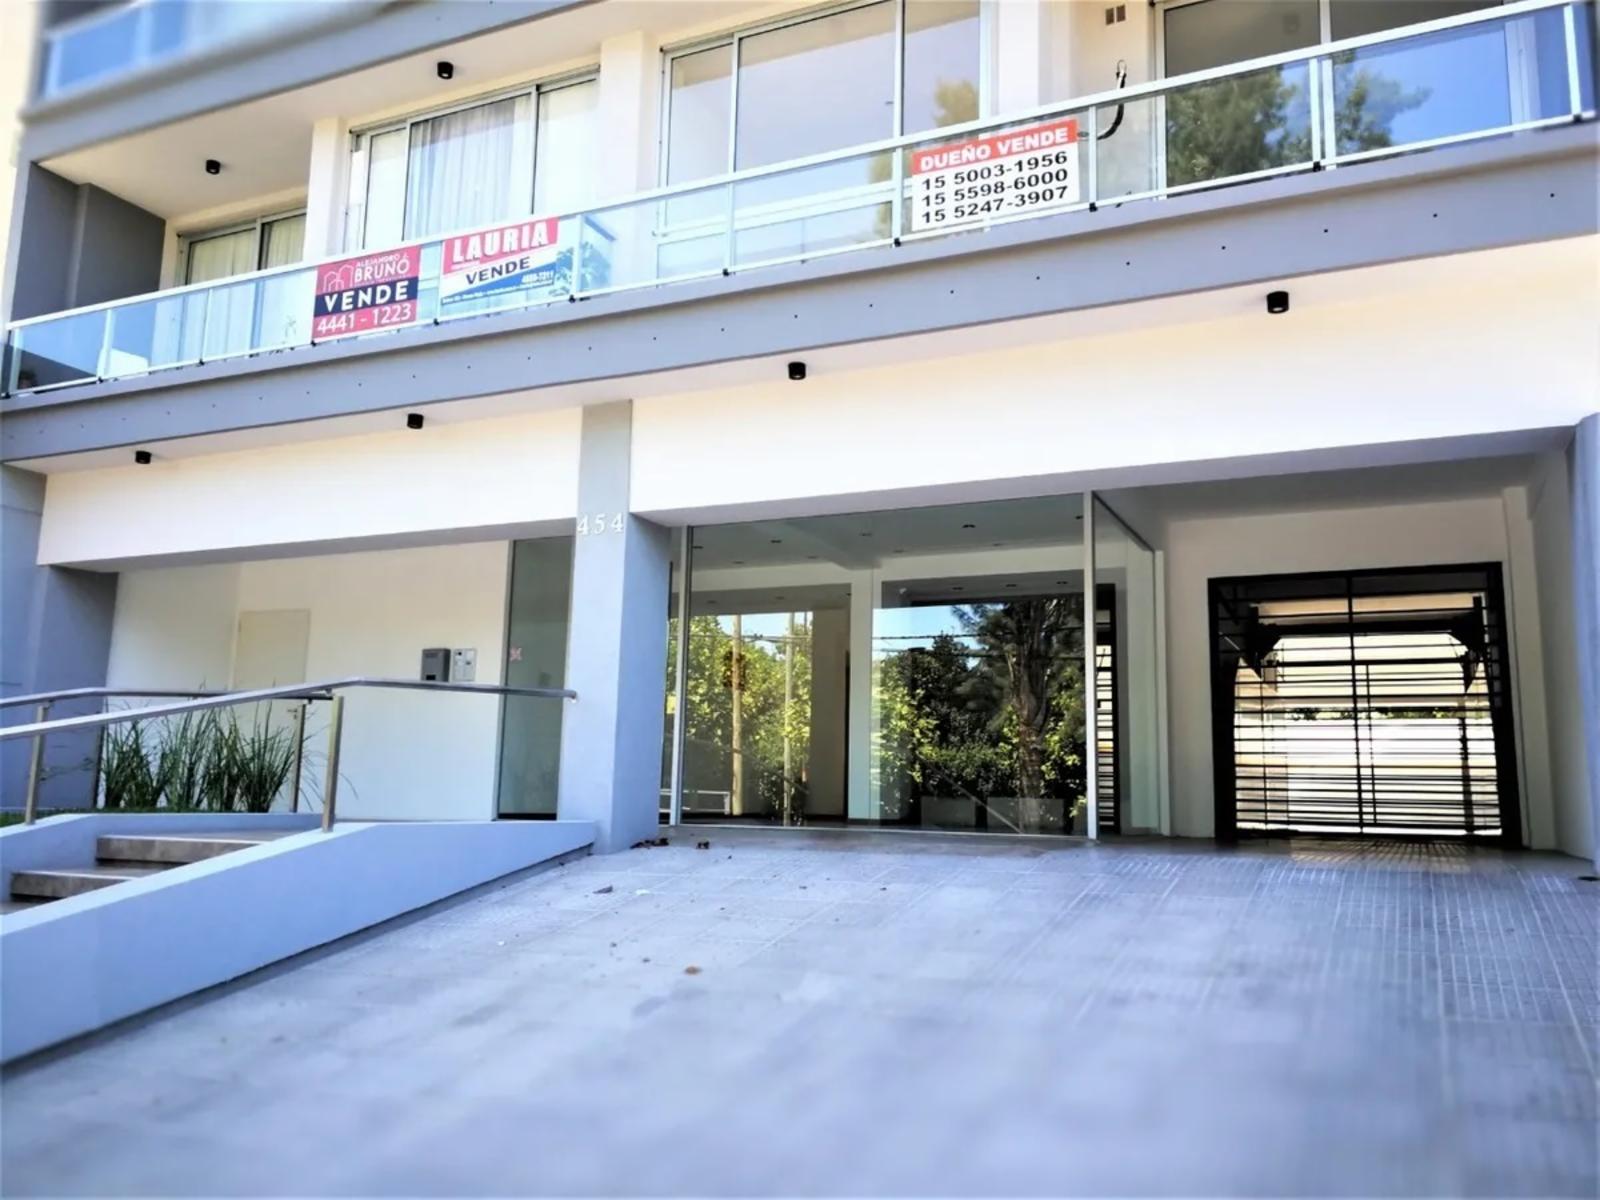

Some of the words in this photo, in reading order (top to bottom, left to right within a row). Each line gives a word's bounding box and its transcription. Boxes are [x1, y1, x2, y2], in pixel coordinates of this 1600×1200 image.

[920, 144, 991, 172] DUEÑO
[997, 127, 1069, 154] VENDE
[922, 175, 946, 191] 15
[954, 151, 1068, 185] 5003-1956
[922, 192, 946, 207] 15
[954, 168, 1068, 202] 5598-6000
[922, 209, 946, 224] 15
[954, 186, 1068, 218] 5247-3907
[452, 221, 550, 264] LAURIA
[465, 256, 531, 285] VENDE
[324, 280, 409, 313] VENDE
[317, 313, 355, 334] 4441
[373, 303, 411, 326] 1223
[577, 513, 624, 536] 454
